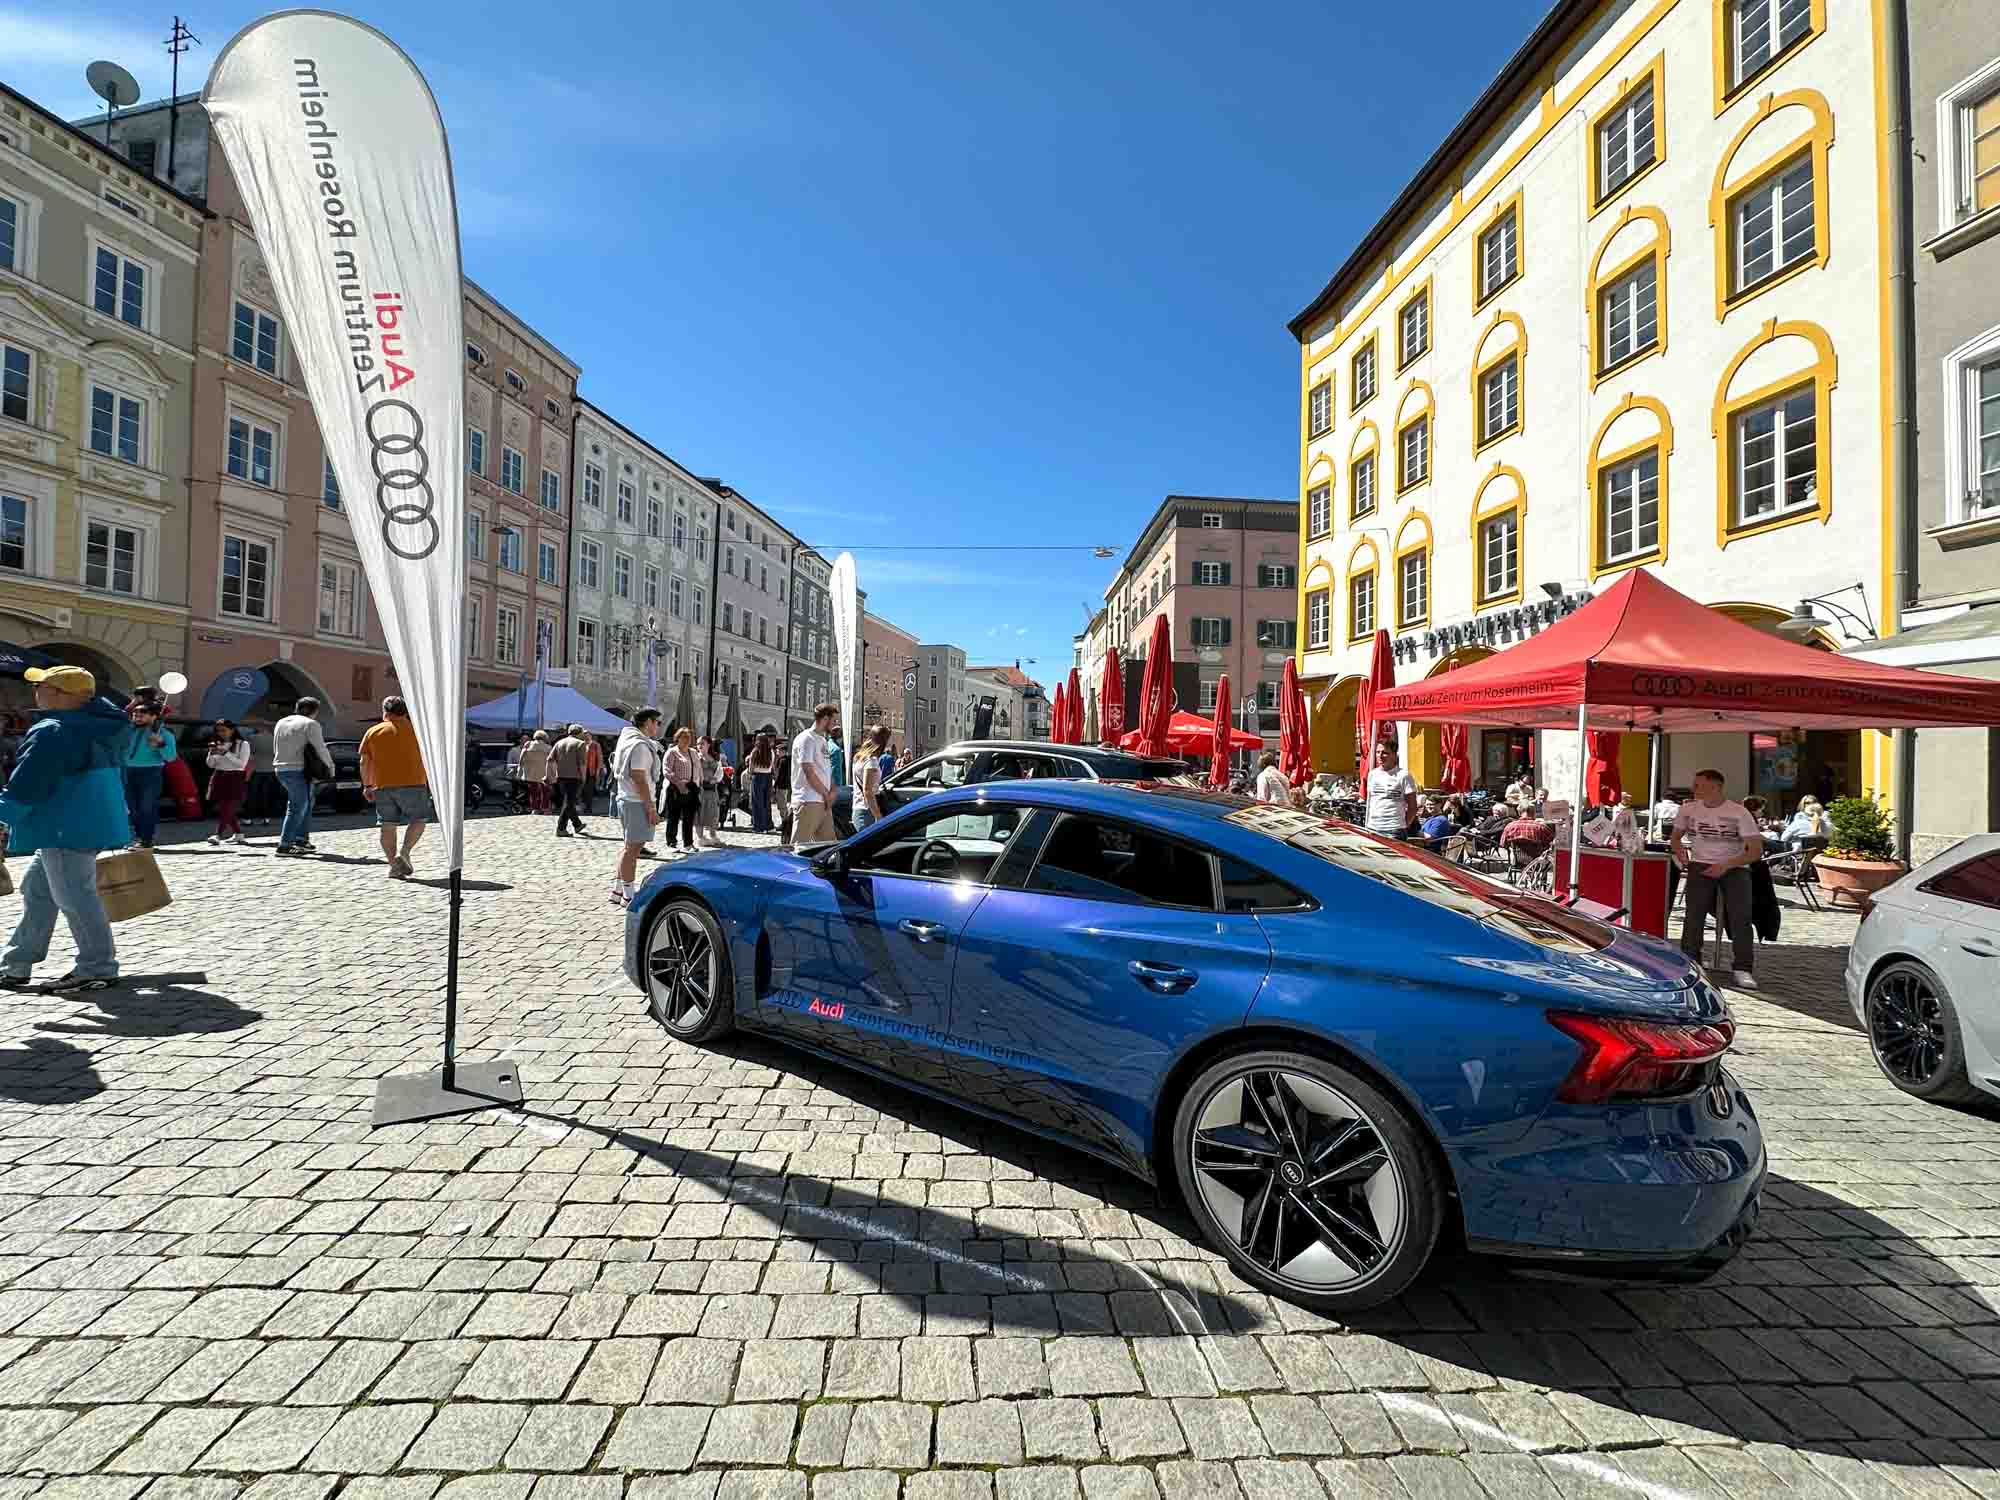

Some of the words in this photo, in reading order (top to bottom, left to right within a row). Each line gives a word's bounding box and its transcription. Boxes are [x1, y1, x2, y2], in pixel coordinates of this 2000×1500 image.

[1413, 694, 1435, 706] Audi
[1437, 691, 1481, 704] Zentrum
[1484, 679, 1554, 698] Rosenheim
[1702, 679, 1752, 696] Audi
[808, 997, 845, 1020] Audi
[849, 1007, 919, 1037] Zentrum
[923, 1022, 1033, 1065] Rosenheim
